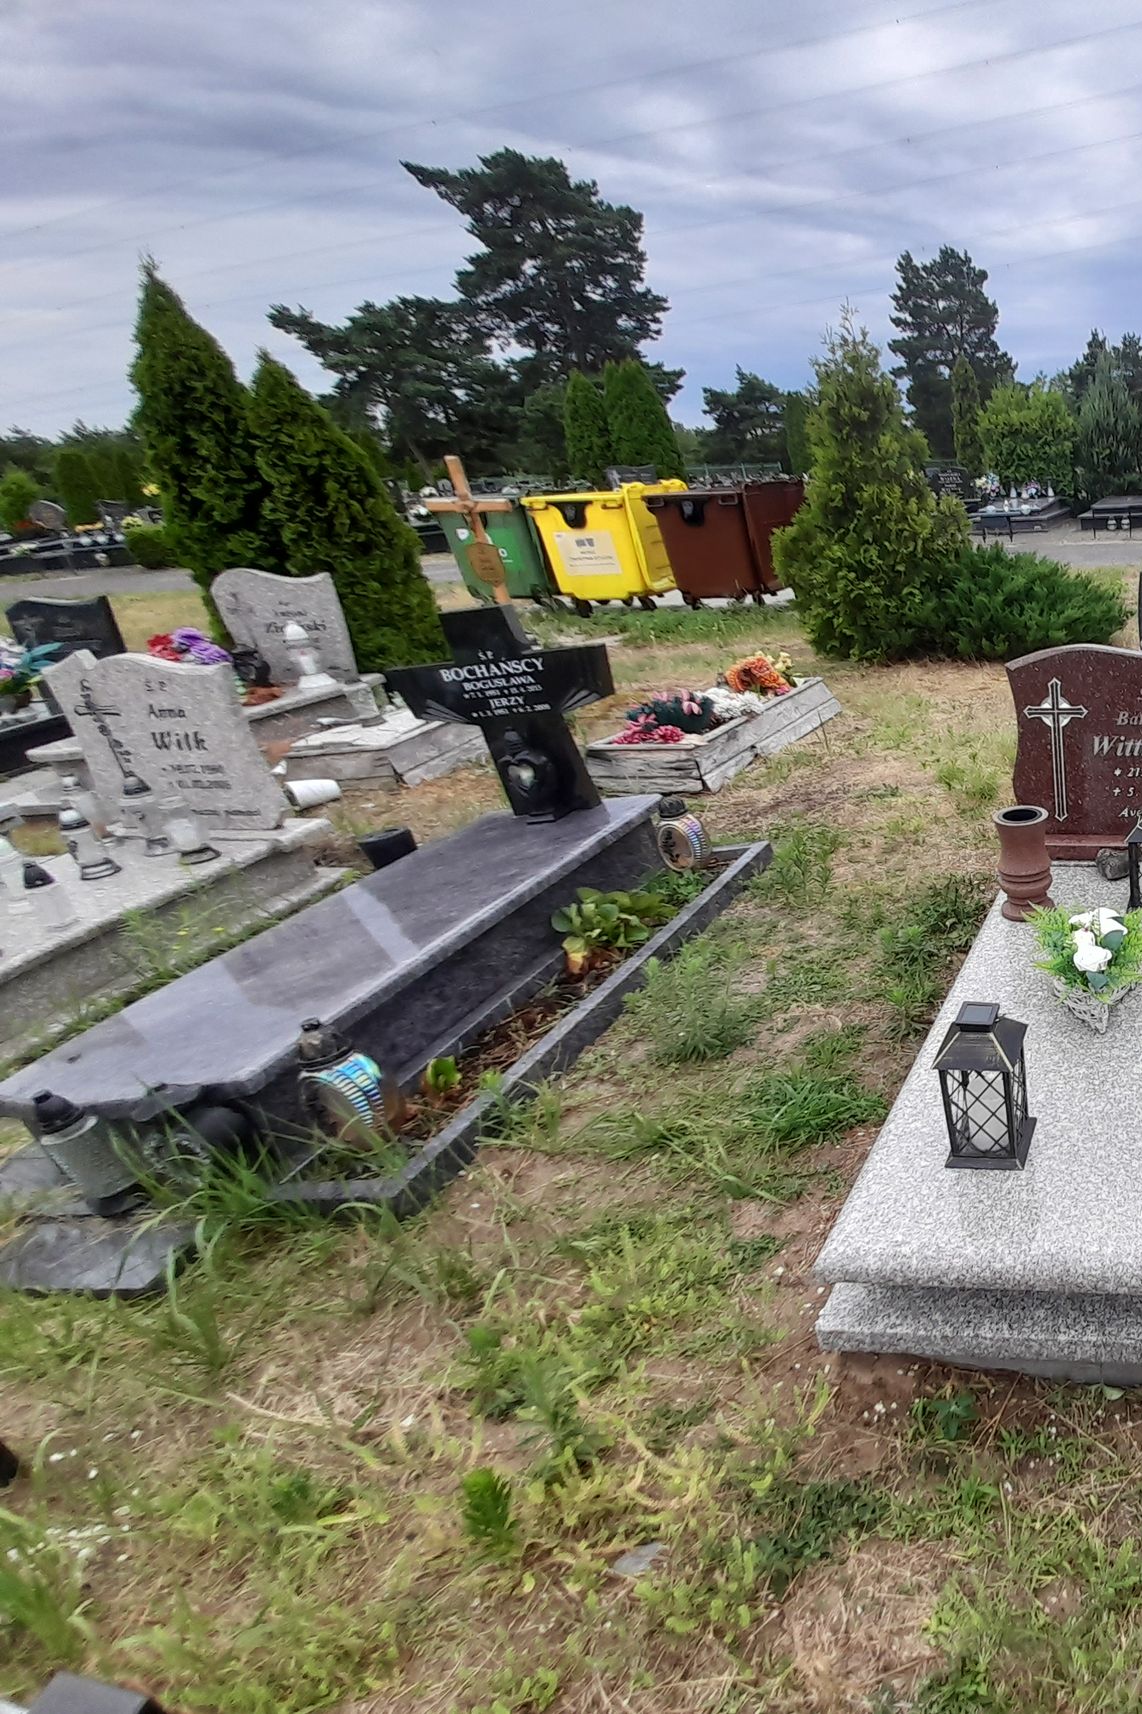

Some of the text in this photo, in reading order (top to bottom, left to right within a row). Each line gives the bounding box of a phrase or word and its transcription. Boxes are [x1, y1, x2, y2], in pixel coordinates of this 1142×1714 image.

[439, 657, 544, 682] BOCHAŃSCY
[489, 696, 525, 709] JERZY
[149, 704, 186, 719] Anna
[151, 731, 208, 751] Wilk
